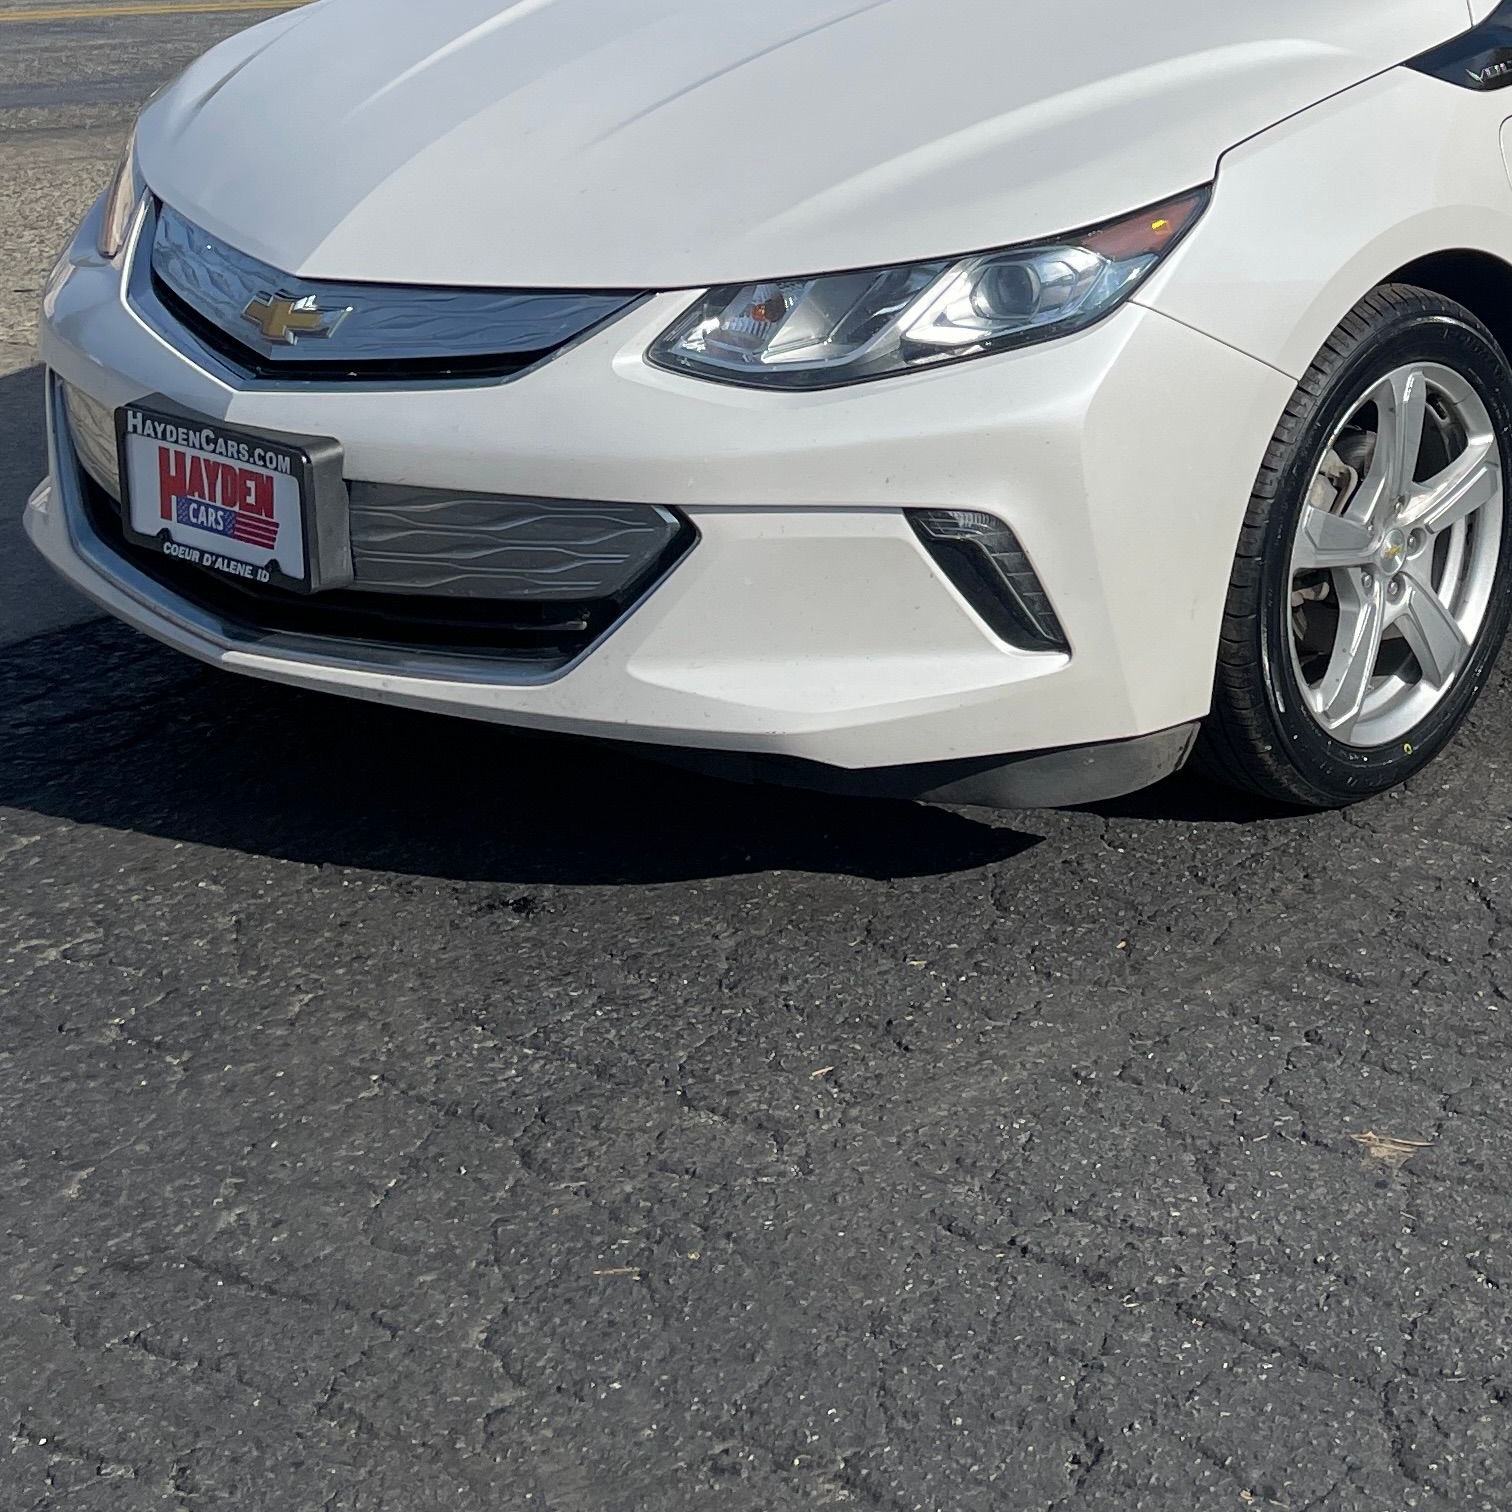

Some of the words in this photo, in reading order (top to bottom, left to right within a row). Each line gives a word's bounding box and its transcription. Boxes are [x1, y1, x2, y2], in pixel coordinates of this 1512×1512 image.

[158, 445, 274, 521] HAYDEN
[188, 503, 225, 531] CARS
[163, 541, 201, 563] COEUR
[256, 569, 270, 583] ID
